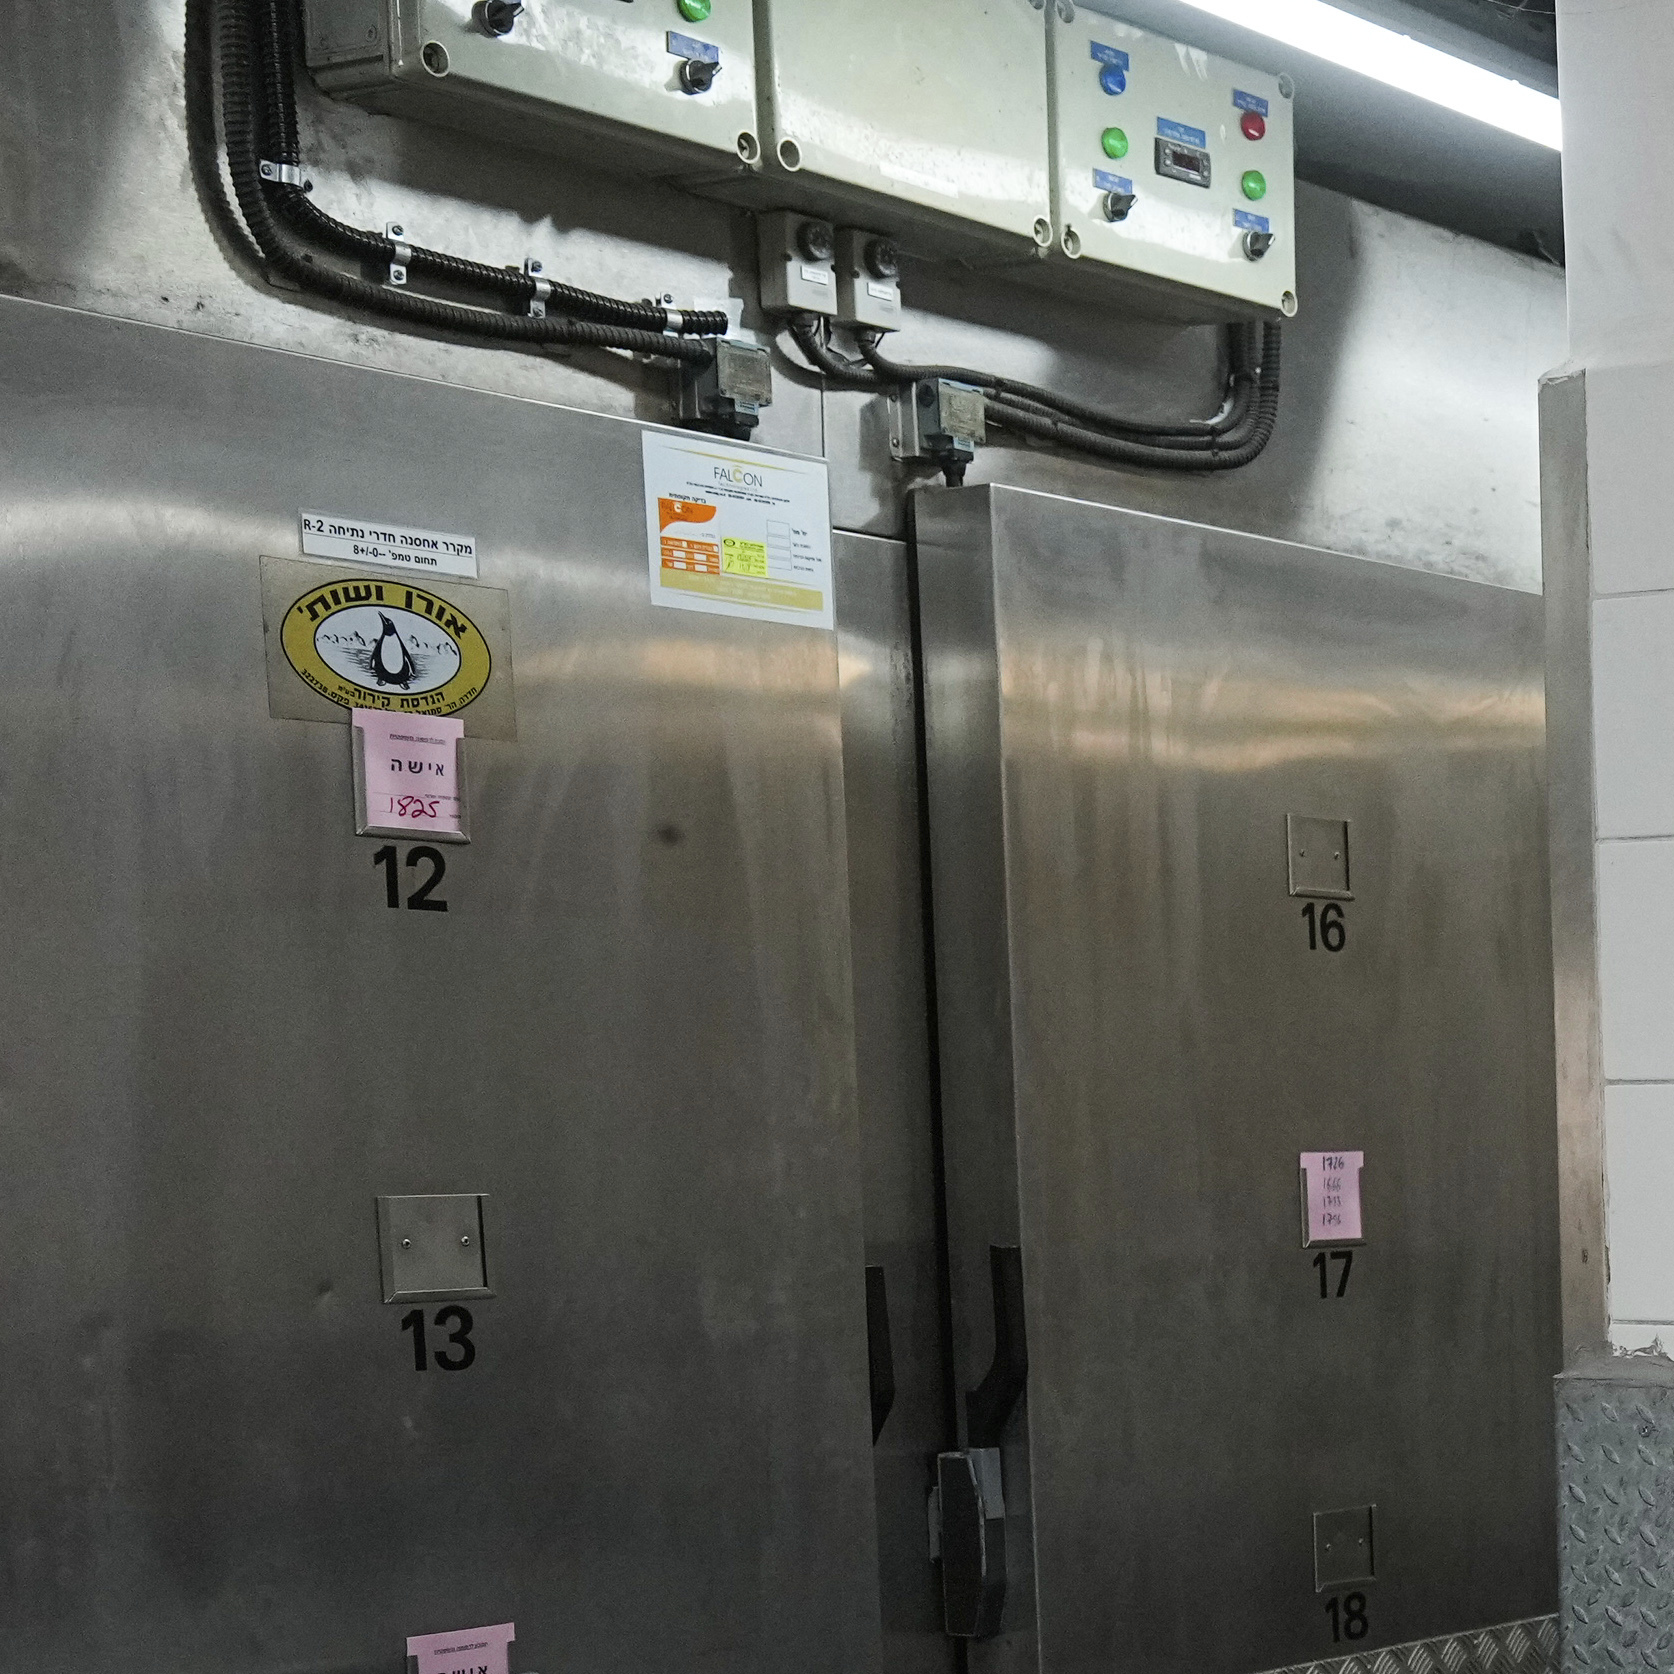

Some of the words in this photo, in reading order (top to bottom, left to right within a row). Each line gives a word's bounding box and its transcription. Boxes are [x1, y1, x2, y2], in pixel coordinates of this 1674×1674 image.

[713, 466, 763, 487] FALCON
[303, 518, 324, 533] R-2
[328, 524, 365, 539] נתיחה
[369, 530, 396, 544] חדרי
[400, 534, 438, 550] אחסנה
[442, 540, 473, 556] מקרר
[414, 555, 438, 566] תחום
[404, 590, 468, 640] אורן
[353, 687, 391, 708] קירור
[401, 691, 445, 708] הנדסת
[391, 758, 445, 777] אישה
[389, 795, 440, 819] 1825
[373, 845, 448, 912] 12
[1301, 902, 1346, 953] 16
[1312, 1250, 1353, 1299] 17
[401, 1304, 476, 1372] 13
[1324, 1591, 1369, 1643] 18
